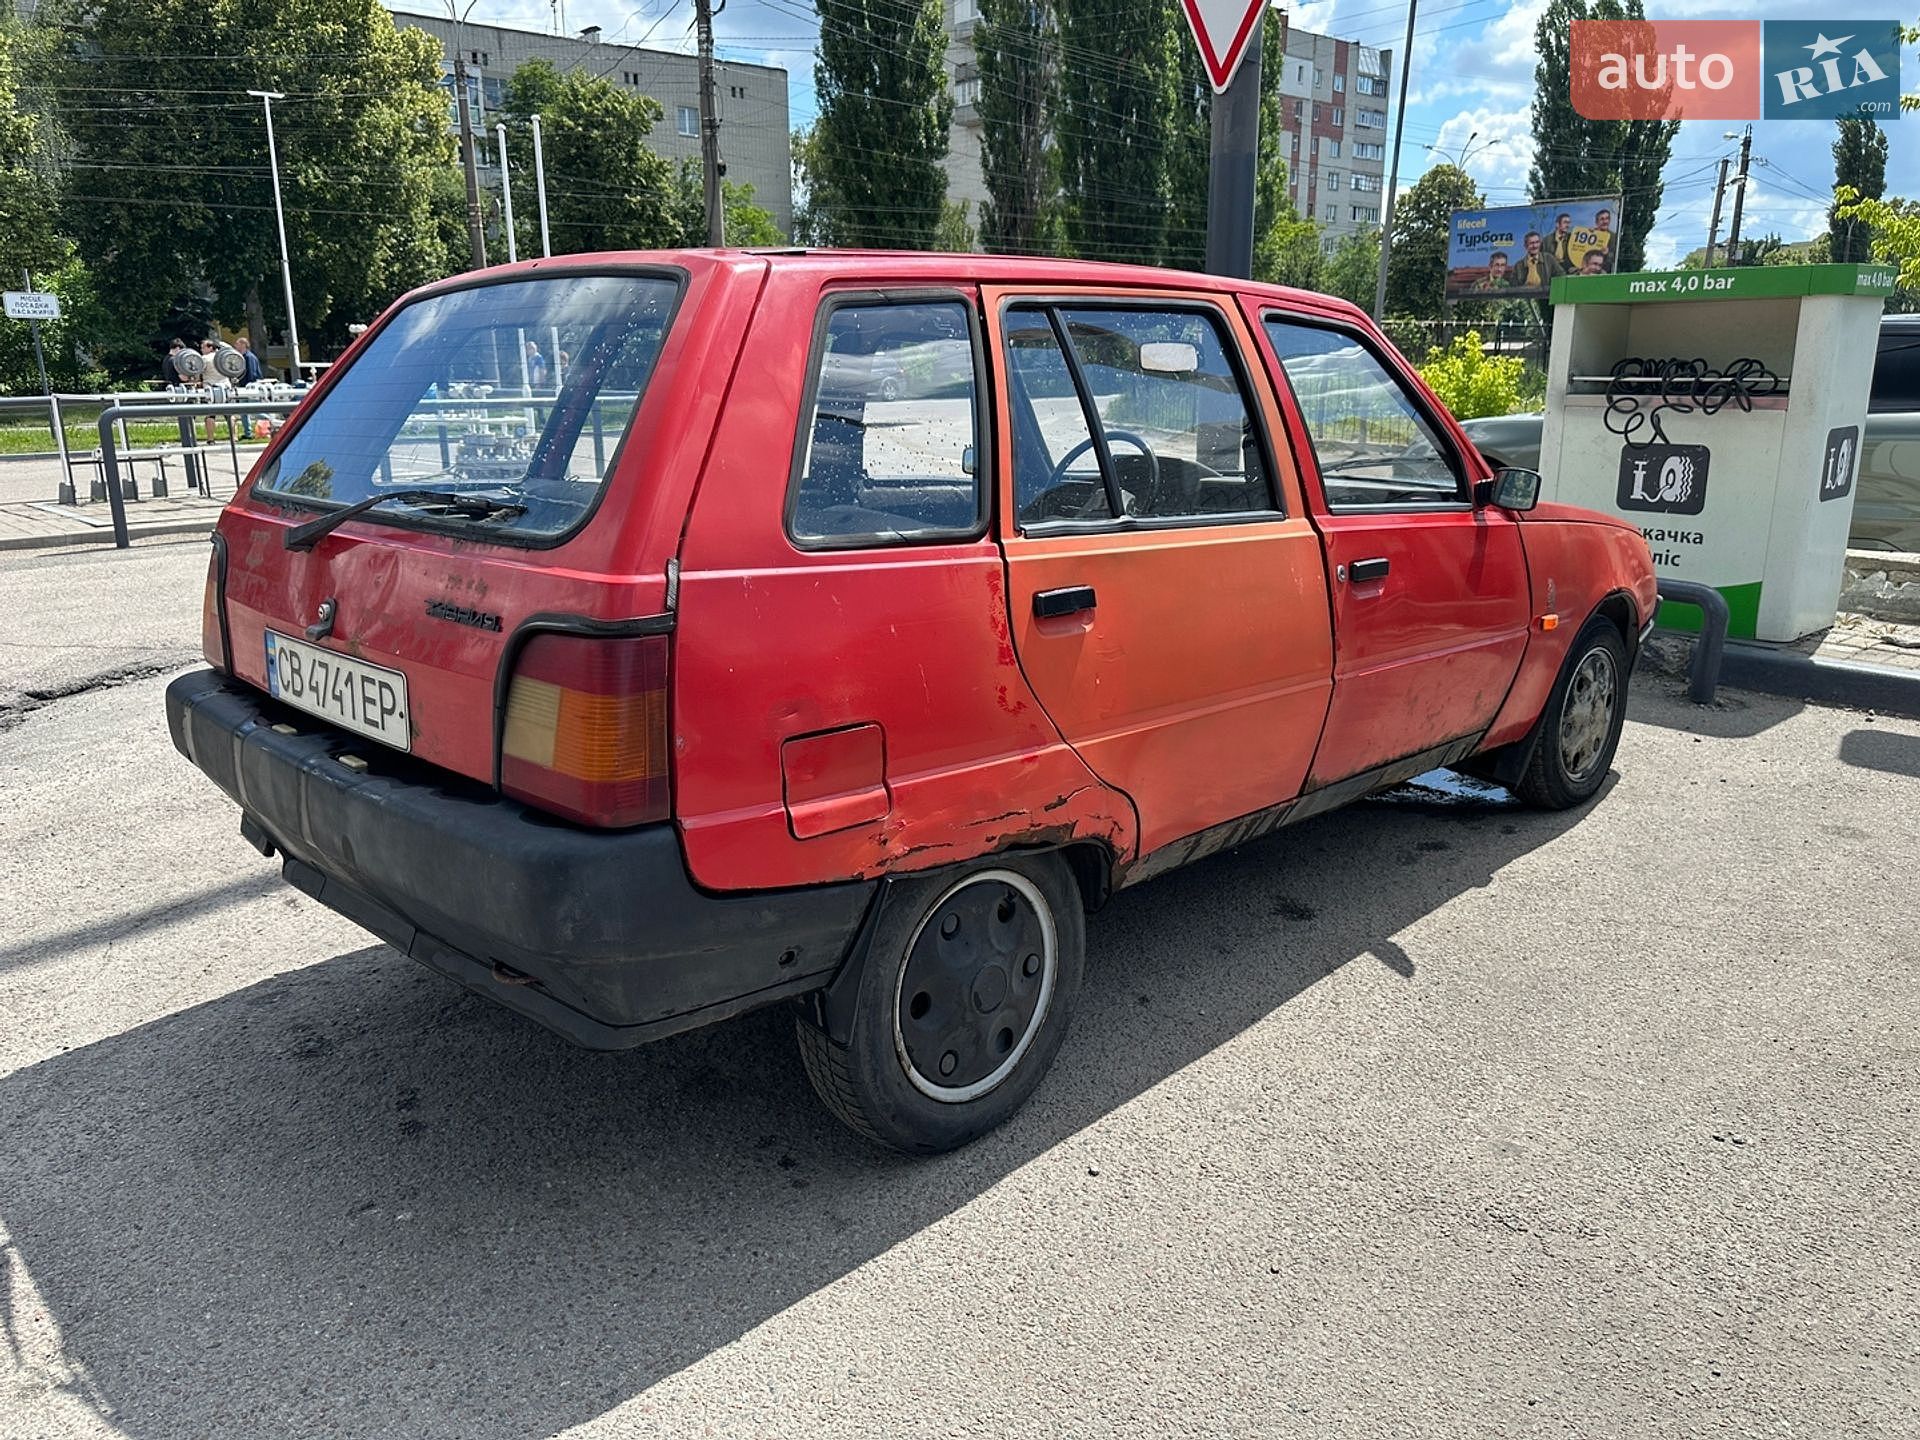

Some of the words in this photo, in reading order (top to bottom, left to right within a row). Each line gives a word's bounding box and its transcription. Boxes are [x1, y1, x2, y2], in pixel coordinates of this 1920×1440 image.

[1456, 218, 1487, 230] lifecell
[1456, 230, 1513, 248] Турбота
[1574, 231, 1597, 246] 190
[1629, 280, 1667, 293] max
[1671, 275, 1699, 293] 4,0
[1703, 274, 1735, 290] bar
[1856, 274, 1871, 286] max
[1882, 271, 1894, 288] bar
[1640, 528, 1704, 545] качка
[1652, 549, 1681, 567] ліс
